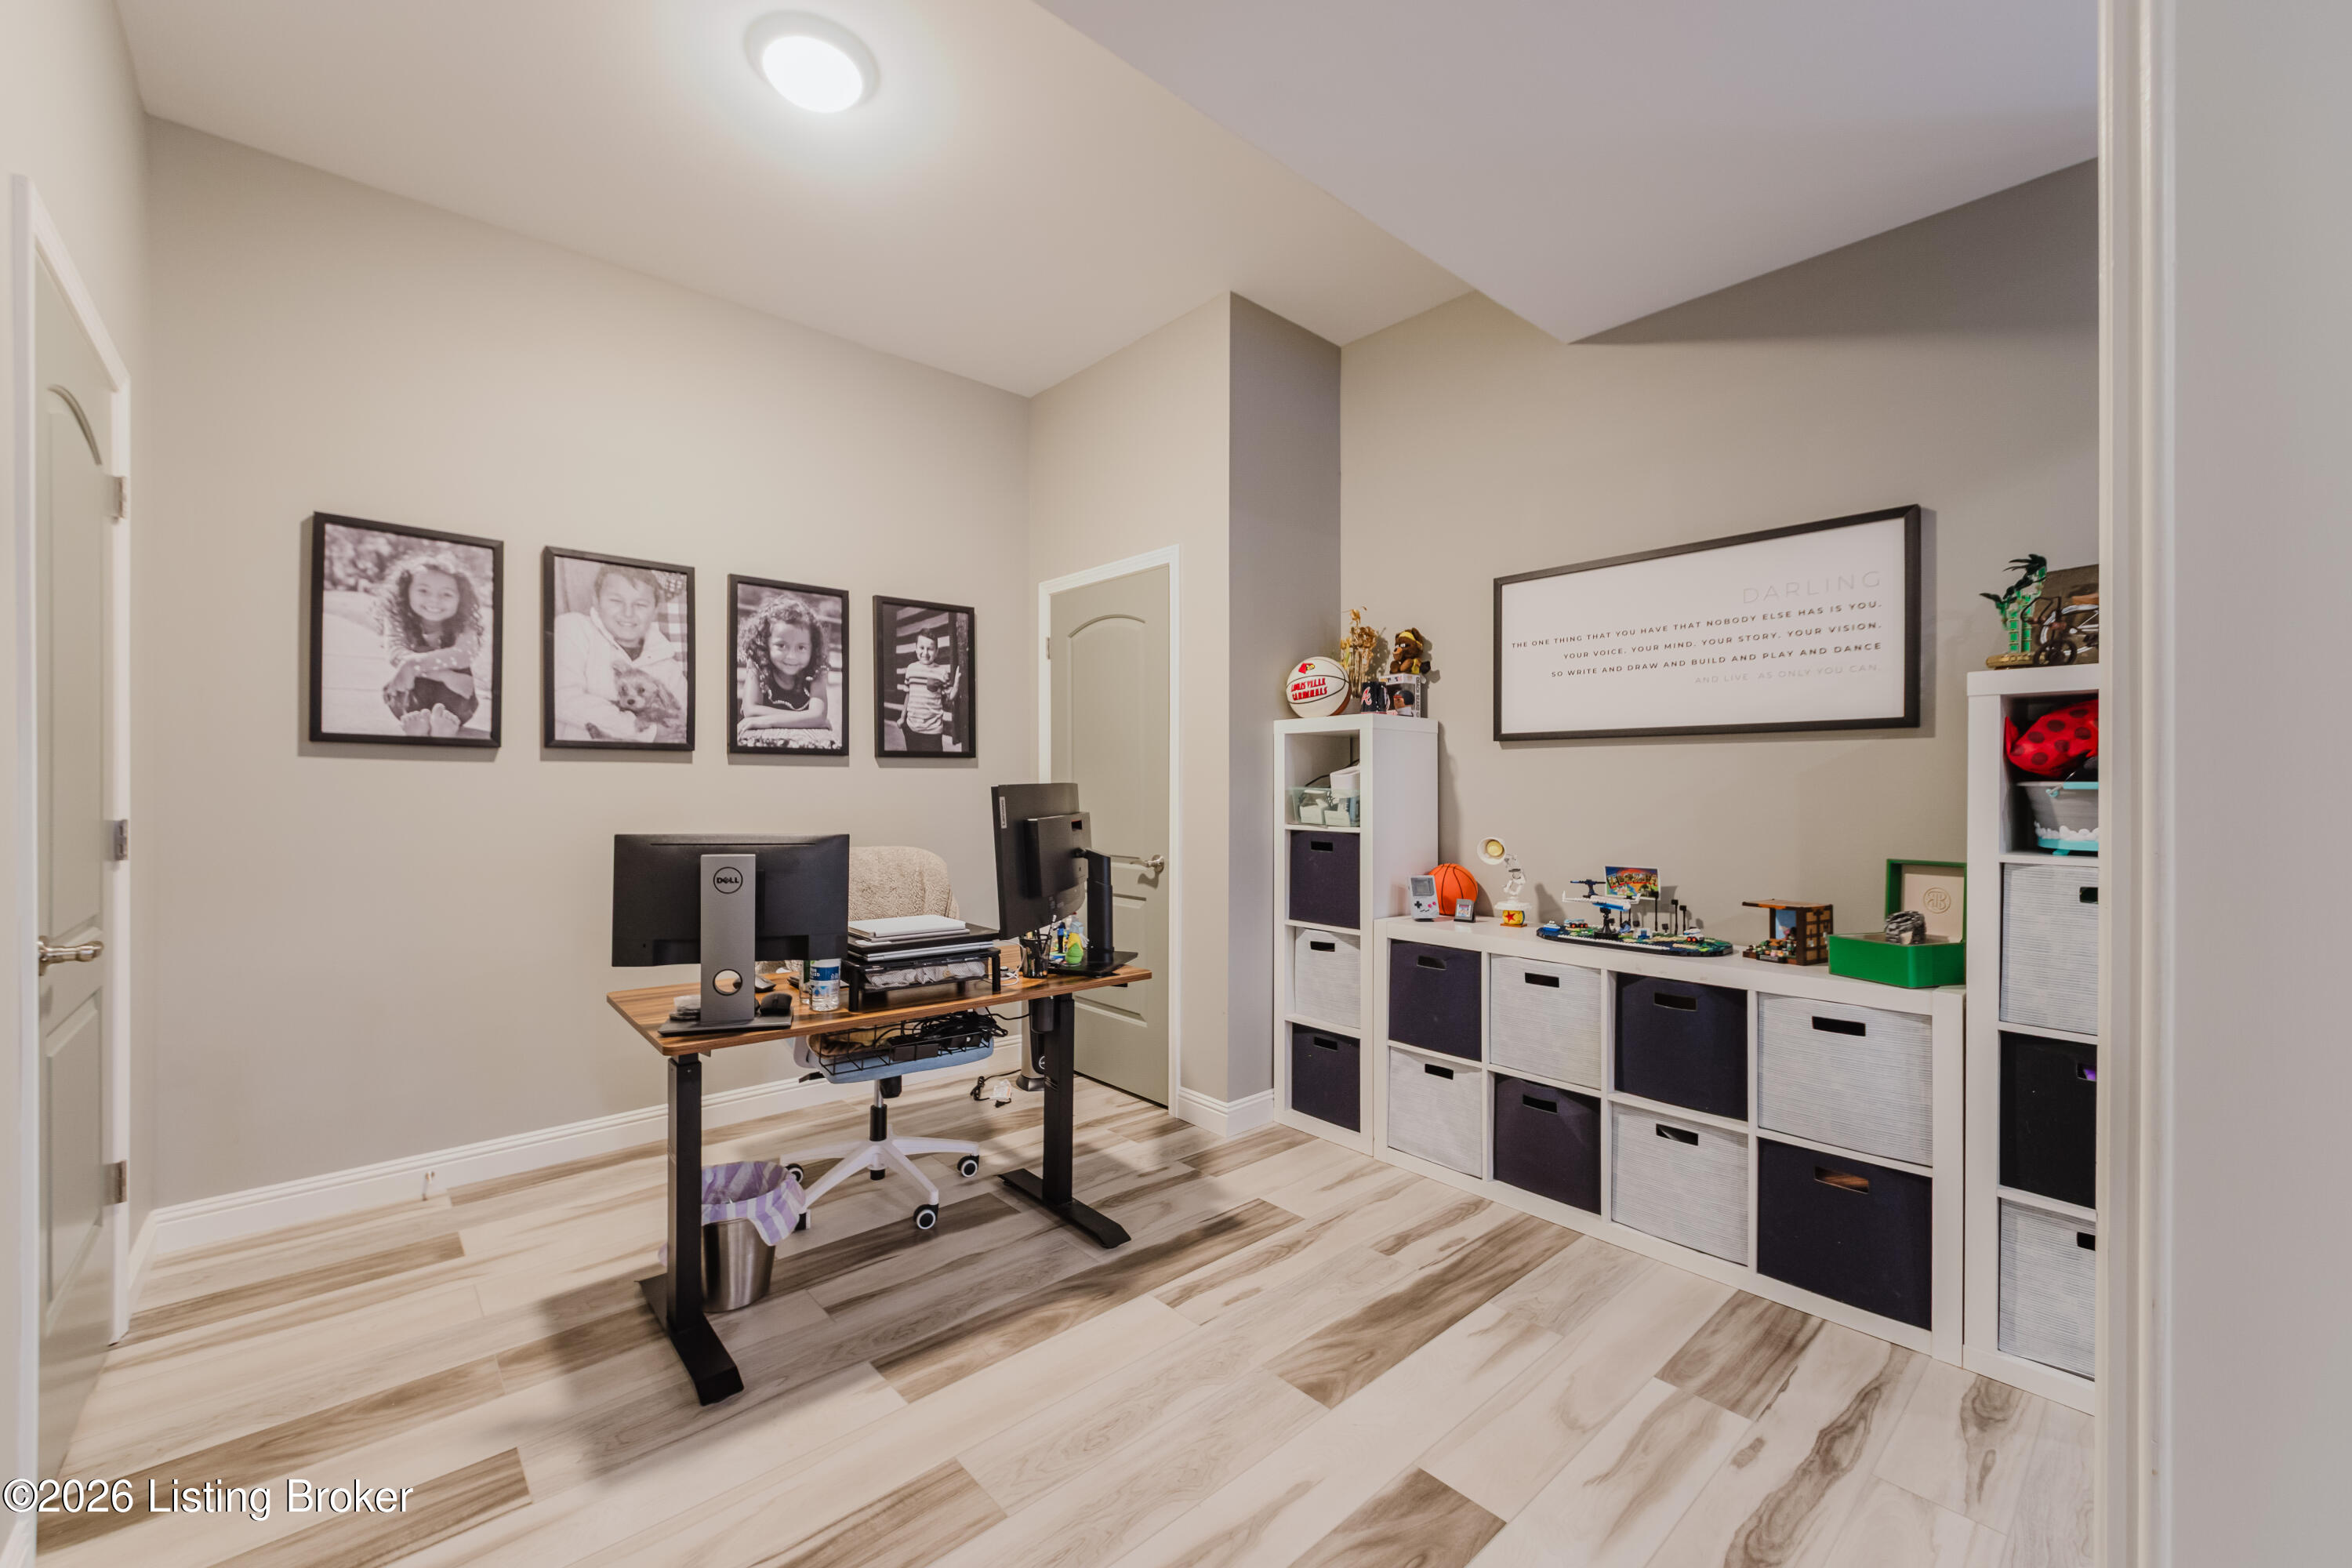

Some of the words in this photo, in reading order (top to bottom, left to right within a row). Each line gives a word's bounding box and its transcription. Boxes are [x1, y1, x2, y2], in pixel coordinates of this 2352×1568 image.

[1743, 571, 1880, 604] DARLING
[1554, 635, 1582, 644] THING
[1673, 621, 1700, 630] THAT
[1707, 615, 1756, 626] NOBODY
[1762, 612, 1791, 620] ELSE
[1798, 607, 1824, 616] HAS
[1849, 601, 1882, 610] YOU.
[1701, 637, 1733, 646] YOUR
[1738, 633, 1781, 642] STORY.
[1788, 628, 1822, 637] YOUR
[1828, 622, 1882, 633] VISION.
[1691, 656, 1726, 666] BUILD
[1732, 654, 1757, 662] AND
[1762, 651, 1794, 659] PLAY
[1800, 648, 1828, 656] AND
[1834, 642, 1881, 653] DANCE
[1725, 673, 1748, 681] LIVE
[1778, 668, 1811, 678] ONLY
[1817, 666, 1844, 674] YOU
